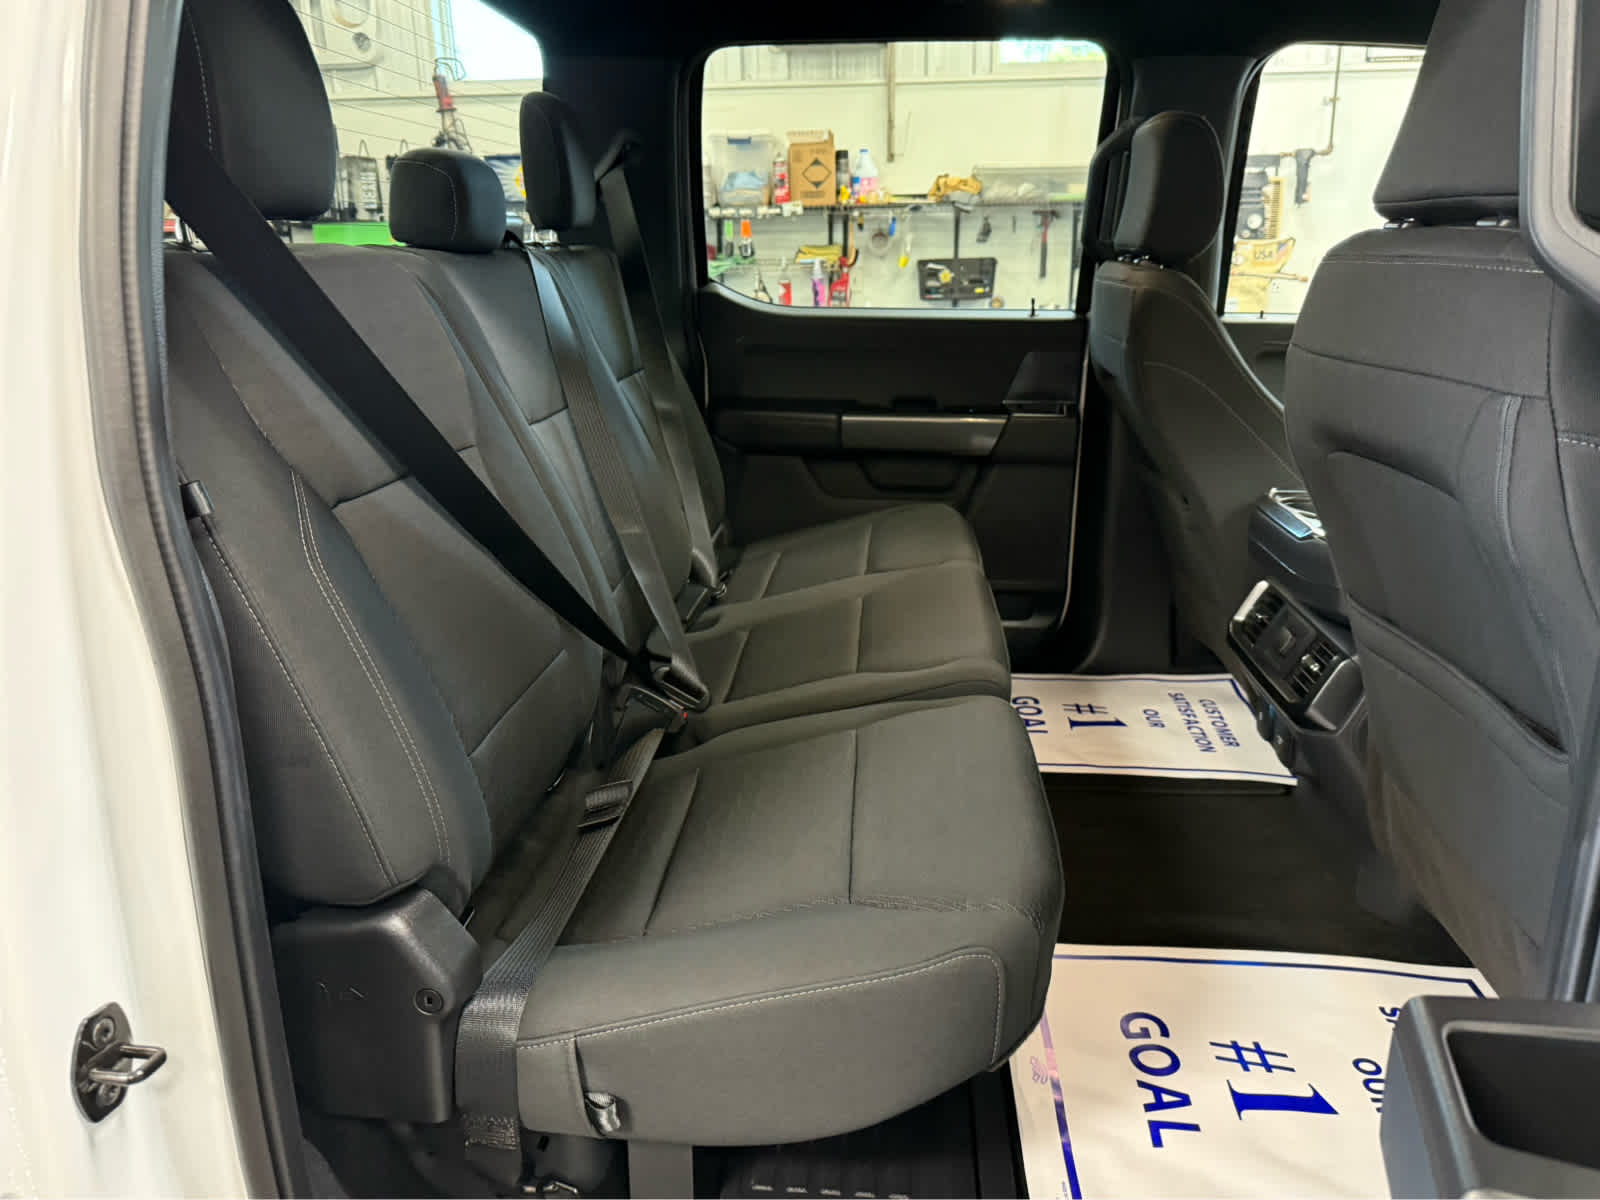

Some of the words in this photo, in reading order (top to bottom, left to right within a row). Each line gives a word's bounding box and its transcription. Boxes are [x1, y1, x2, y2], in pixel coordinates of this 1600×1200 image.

[1061, 703, 1128, 730] #1
[1143, 708, 1165, 728] OUR
[1168, 692, 1216, 753] SATISFACTION
[1199, 699, 1240, 747] CUSTOMER
[1119, 1011, 1202, 1148] GOAL
[1208, 1040, 1339, 1120] #1
[1352, 1057, 1385, 1113] OU
